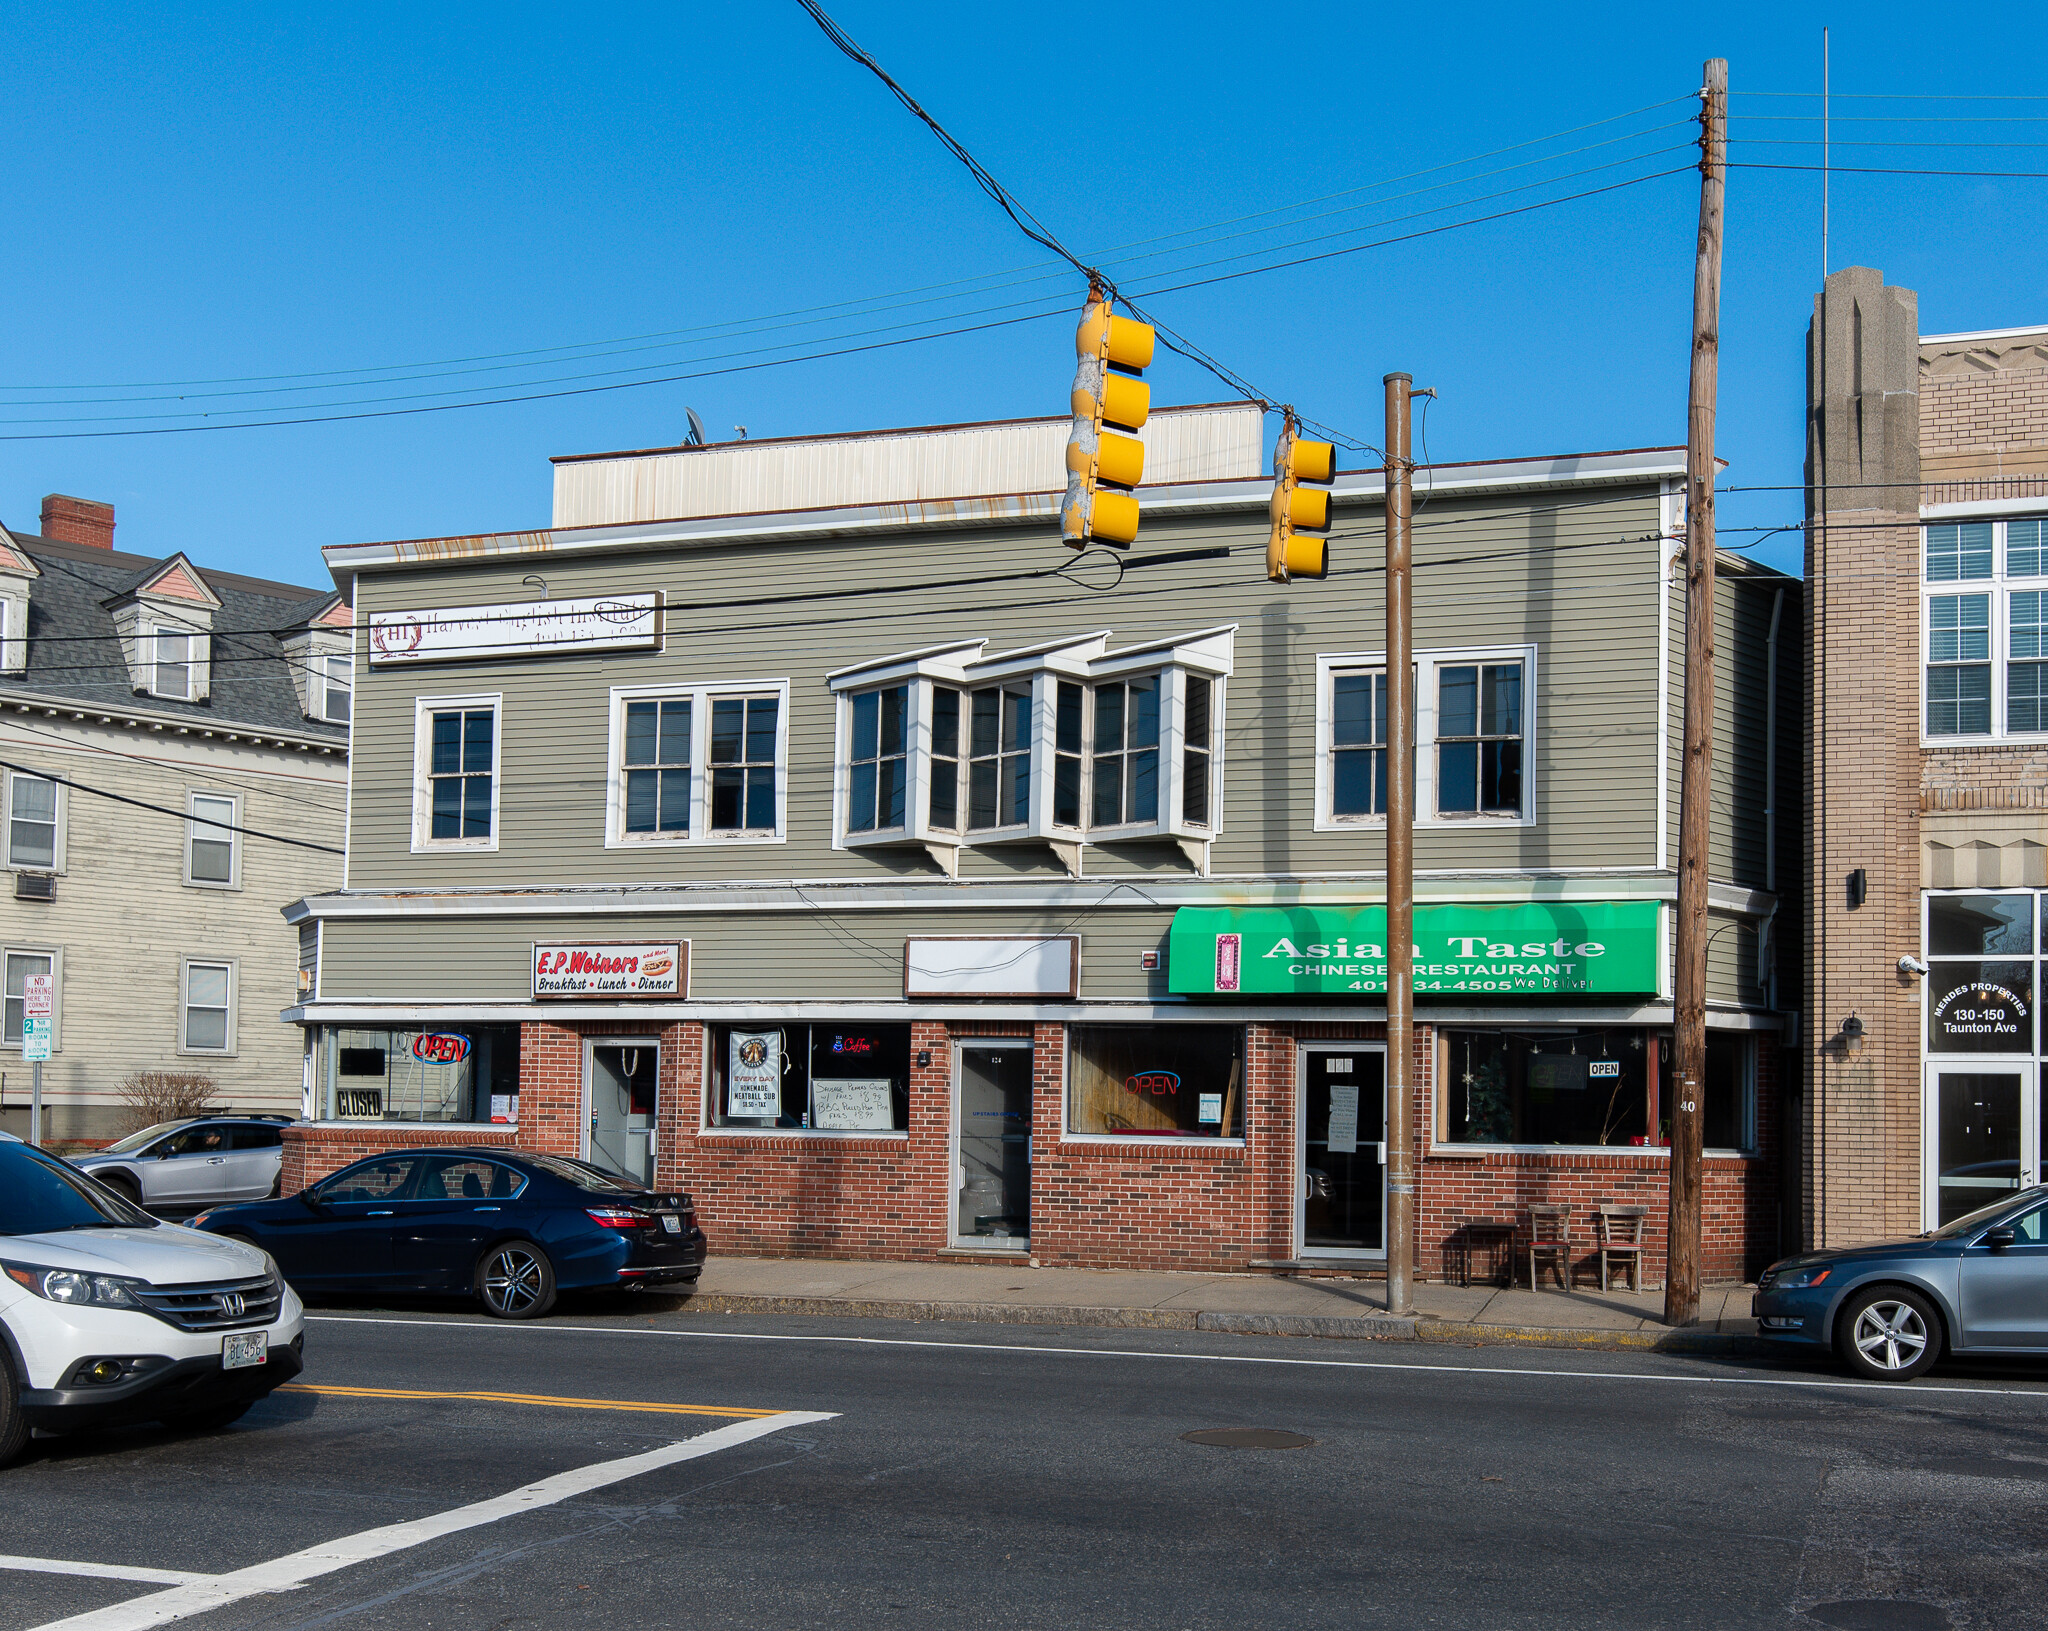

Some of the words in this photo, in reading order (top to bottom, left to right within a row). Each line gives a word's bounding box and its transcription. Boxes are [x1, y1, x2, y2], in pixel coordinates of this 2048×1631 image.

[1447, 937, 1606, 958] Taste
[1288, 964, 1388, 976] CHINESE
[1413, 964, 1576, 976] RESTAURANT
[34, 978, 45, 986] NO
[539, 977, 587, 990] Breakfast
[597, 977, 627, 990] Lunch
[638, 976, 673, 990] Dinner
[1514, 976, 1536, 988] We
[1543, 976, 1594, 989] Deliver
[27, 987, 52, 995] PARKING
[1933, 985, 1968, 1017] MENDES
[1970, 982, 2027, 1017] PROPERTIES
[1954, 1009, 1975, 1021] 130
[25, 1021, 32, 1032] 2
[1943, 1022, 1992, 1033] Taunton
[1994, 1022, 2017, 1033] Ave
[413, 1034, 467, 1062] OPEN
[843, 1037, 871, 1053] Coffee
[1591, 1064, 1618, 1075] OPEN
[740, 1084, 768, 1092] HOMEMADE
[1125, 1076, 1178, 1095] OPEN
[734, 1092, 761, 1100] MEATBALL
[763, 1092, 776, 1100] SUB
[337, 1090, 381, 1117] CLOSED
[1680, 1101, 1696, 1113] 40
